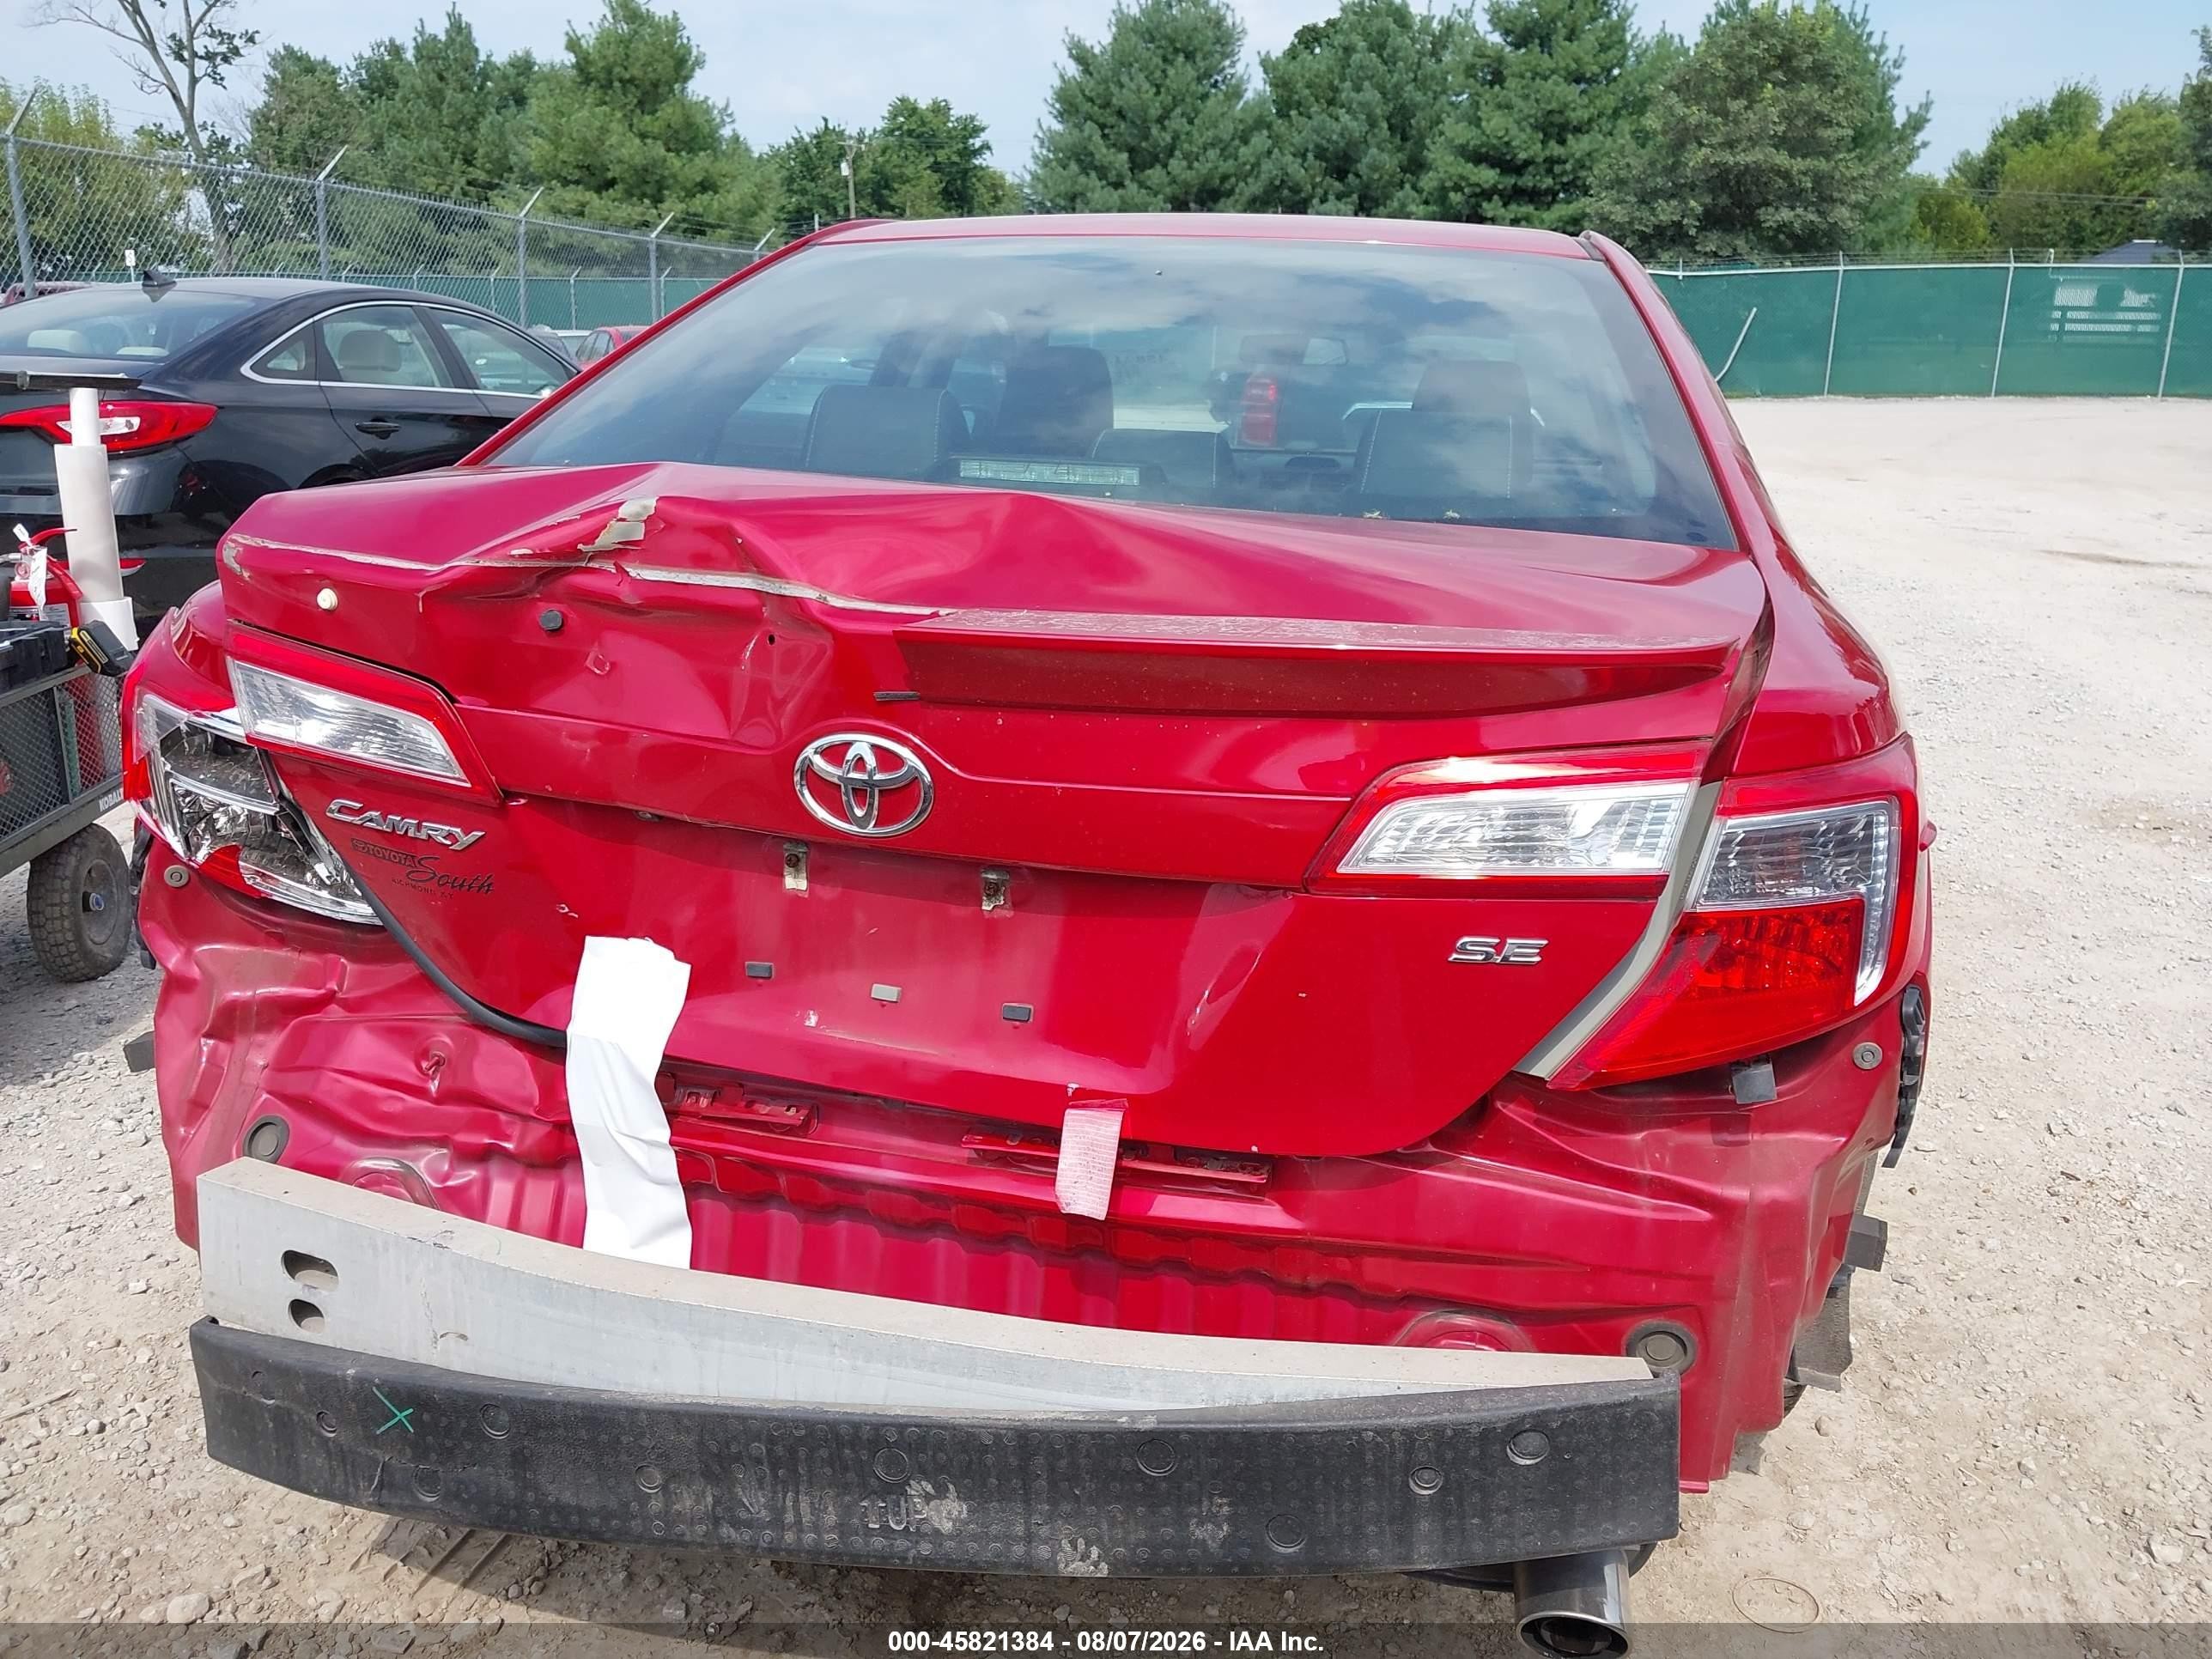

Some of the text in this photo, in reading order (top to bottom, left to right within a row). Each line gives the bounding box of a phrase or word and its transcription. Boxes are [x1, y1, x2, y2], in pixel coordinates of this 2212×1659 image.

[325, 799, 486, 850] CAMRY
[365, 844, 495, 894] TOYOTA South
[1448, 935, 1549, 964] SE
